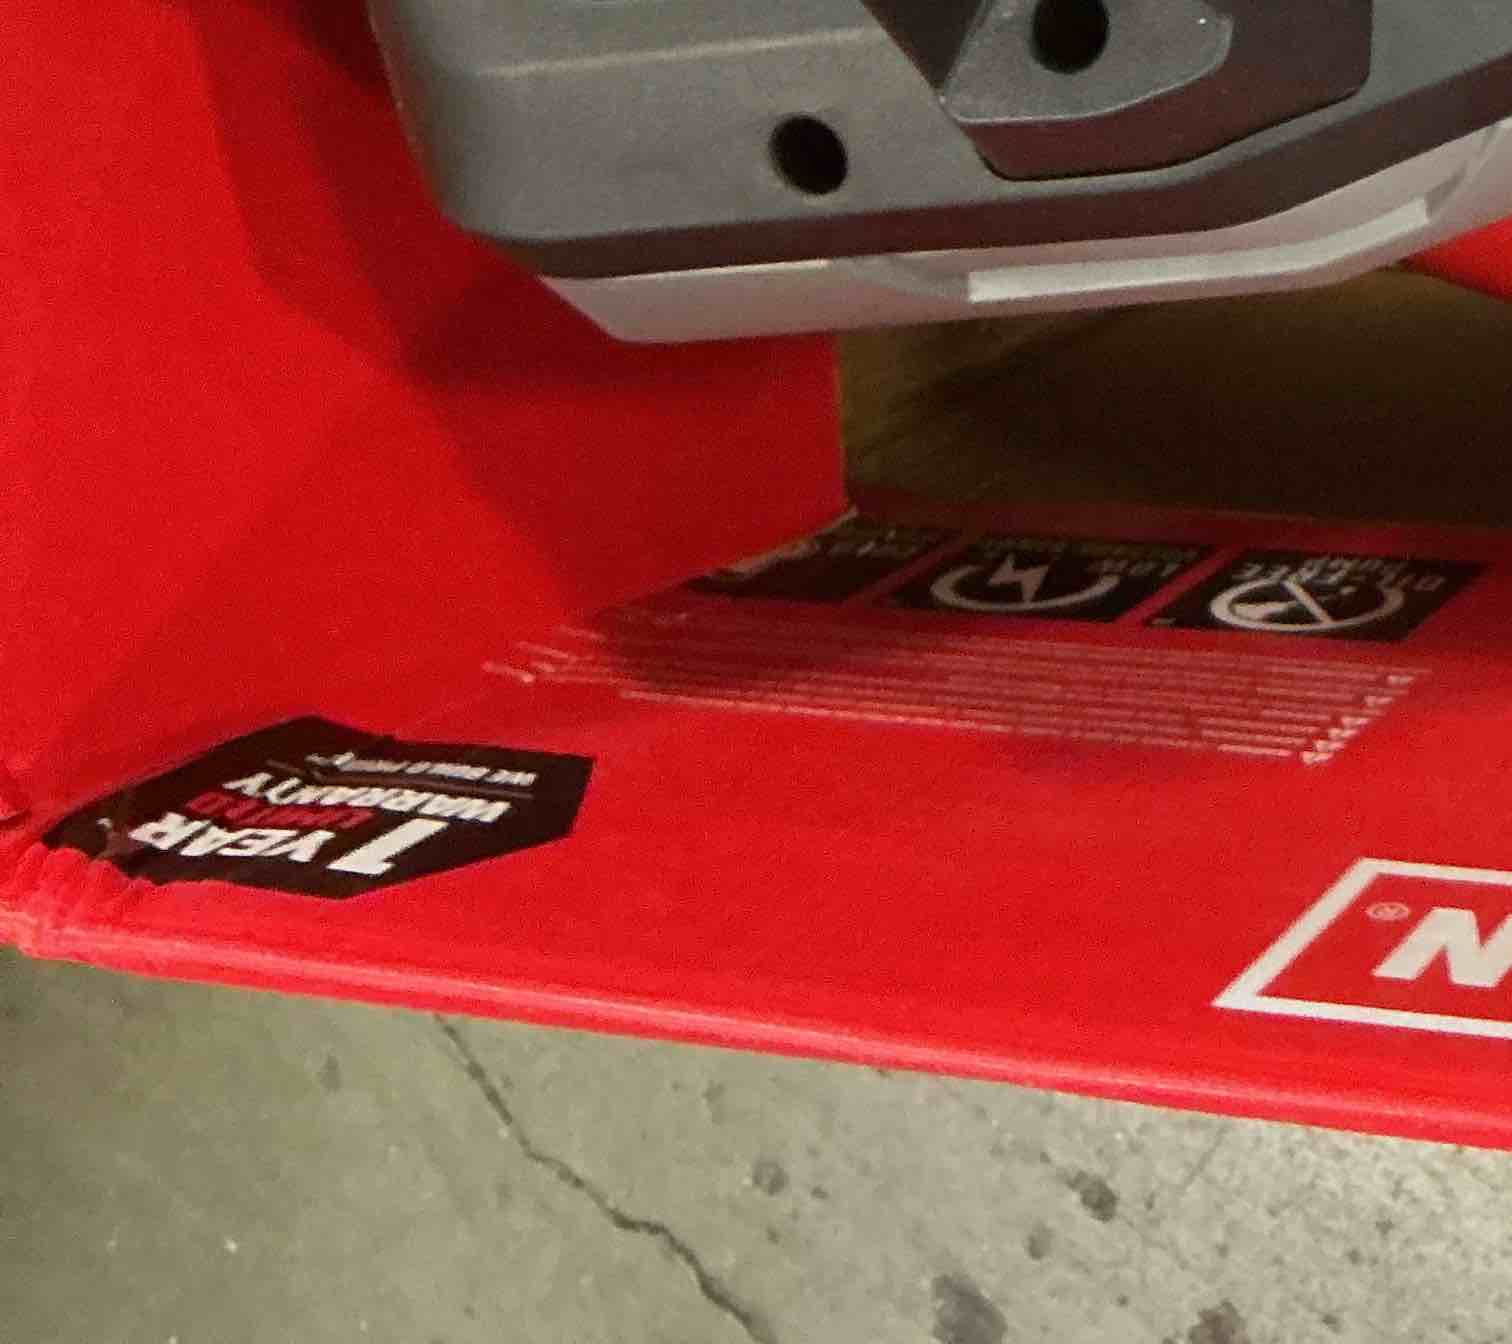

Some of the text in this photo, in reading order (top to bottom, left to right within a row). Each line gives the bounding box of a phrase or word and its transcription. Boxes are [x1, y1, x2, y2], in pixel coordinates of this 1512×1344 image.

[221, 772, 511, 823] WARRANTY
[126, 812, 468, 875] 1 YEAR
